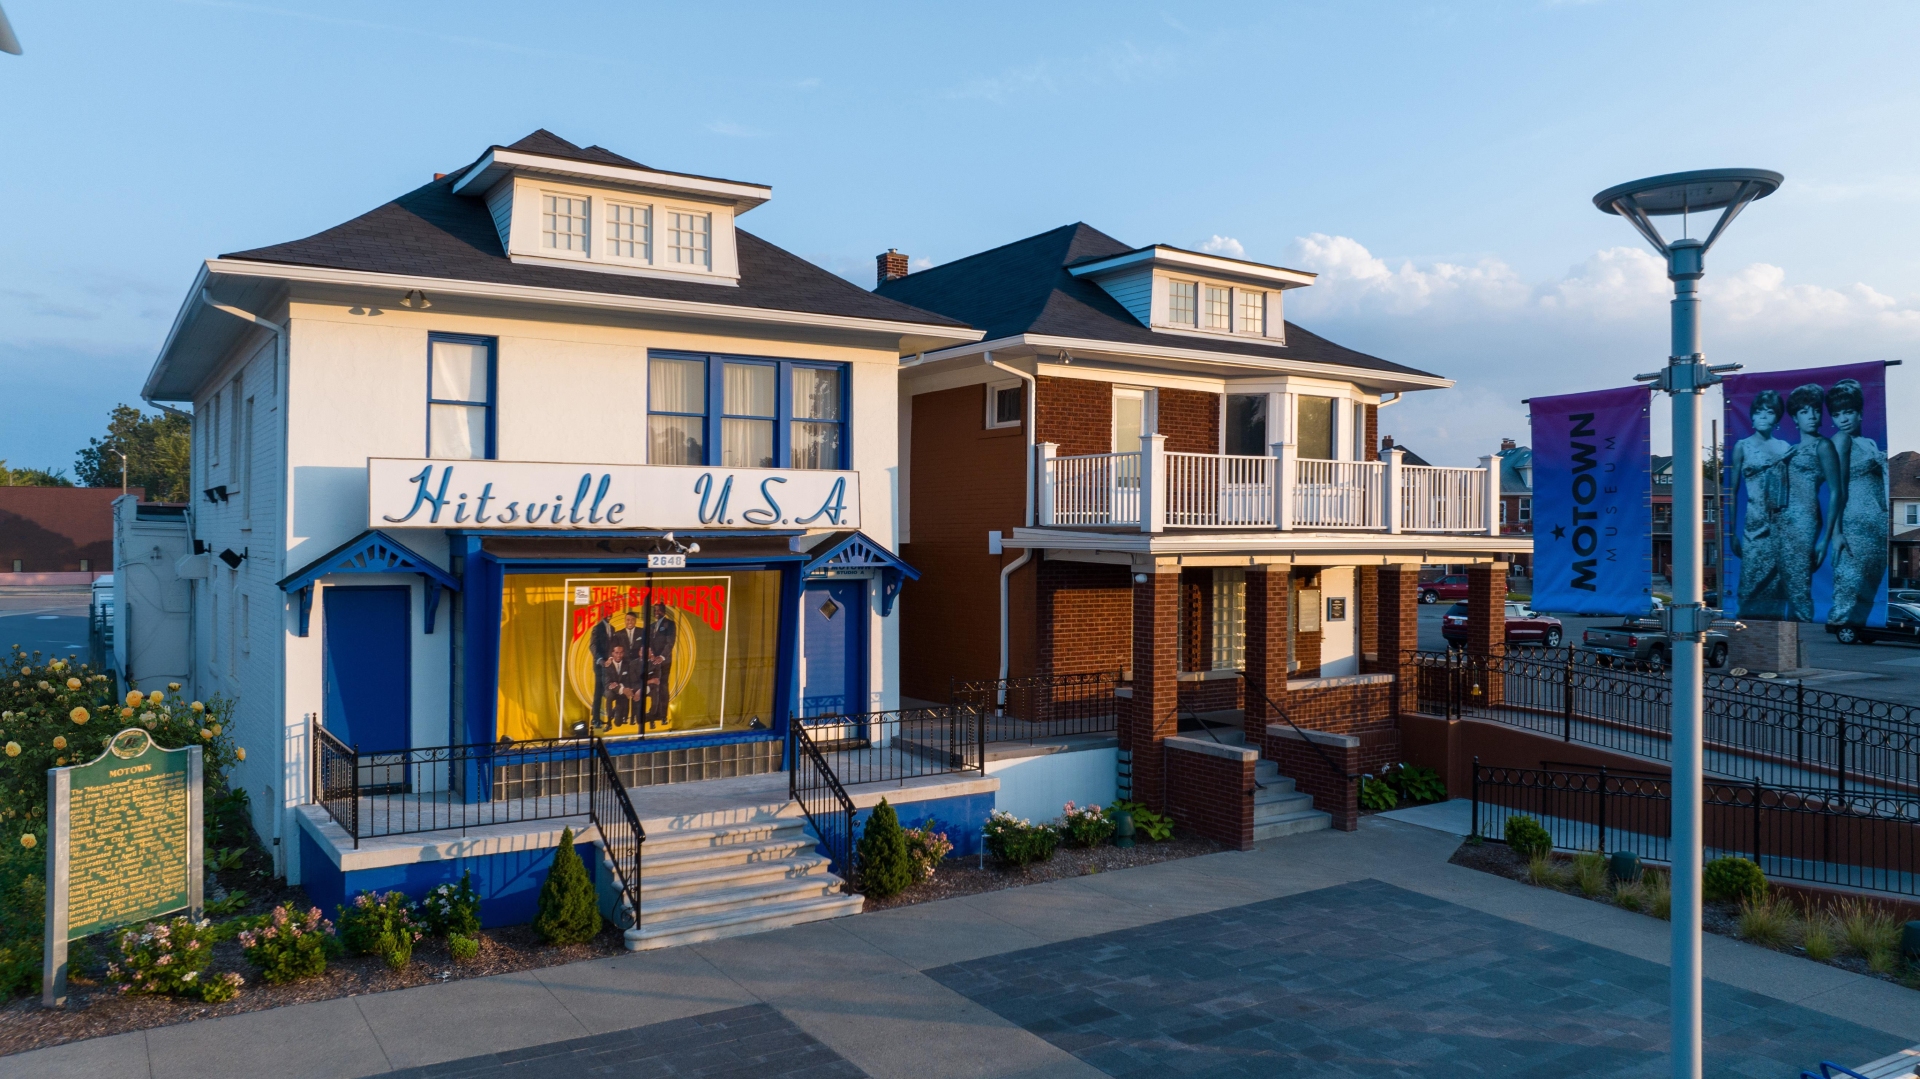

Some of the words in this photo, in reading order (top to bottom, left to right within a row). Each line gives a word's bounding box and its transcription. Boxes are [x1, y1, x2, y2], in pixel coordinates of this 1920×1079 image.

[383, 464, 626, 524] Hitsville
[693, 472, 849, 526] U.S.A.
[1570, 412, 1598, 593] MOTOWN
[1604, 435, 1618, 562] MUSEUM
[652, 556, 682, 566] 2648
[573, 594, 626, 643] DETROIT
[628, 585, 725, 632] SPINNERS
[592, 586, 618, 602] THE
[110, 763, 152, 778] MOTOWN
